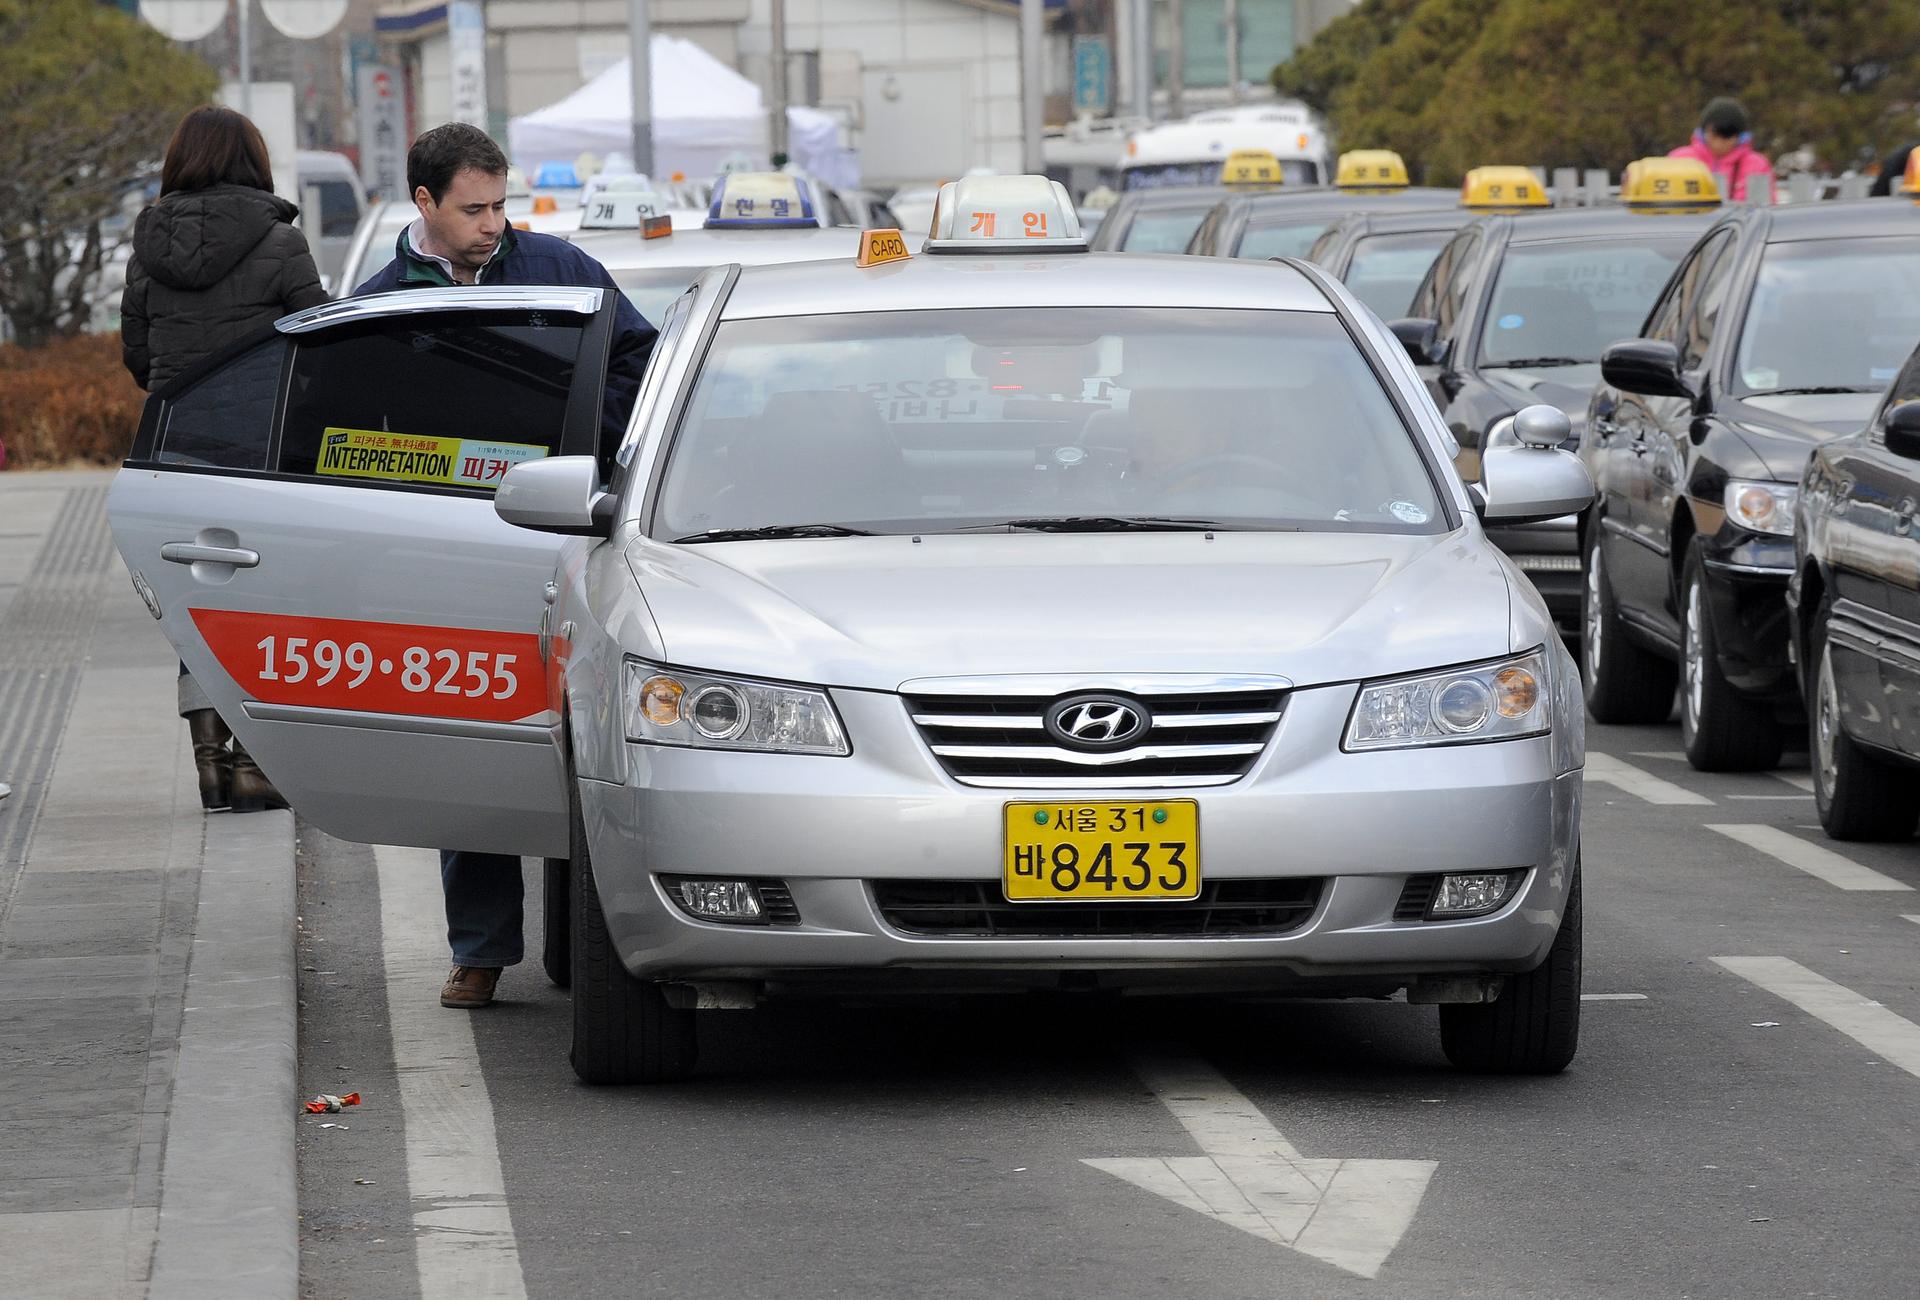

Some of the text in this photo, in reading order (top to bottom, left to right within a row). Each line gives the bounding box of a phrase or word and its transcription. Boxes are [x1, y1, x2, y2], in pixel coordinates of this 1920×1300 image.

[871, 238, 903, 257] CARD
[328, 434, 348, 444] Free
[353, 434, 388, 448] 피커폰
[323, 446, 452, 477] INTERPRETATION
[461, 457, 520, 481] 피커
[1054, 808, 1145, 832] 서울 31
